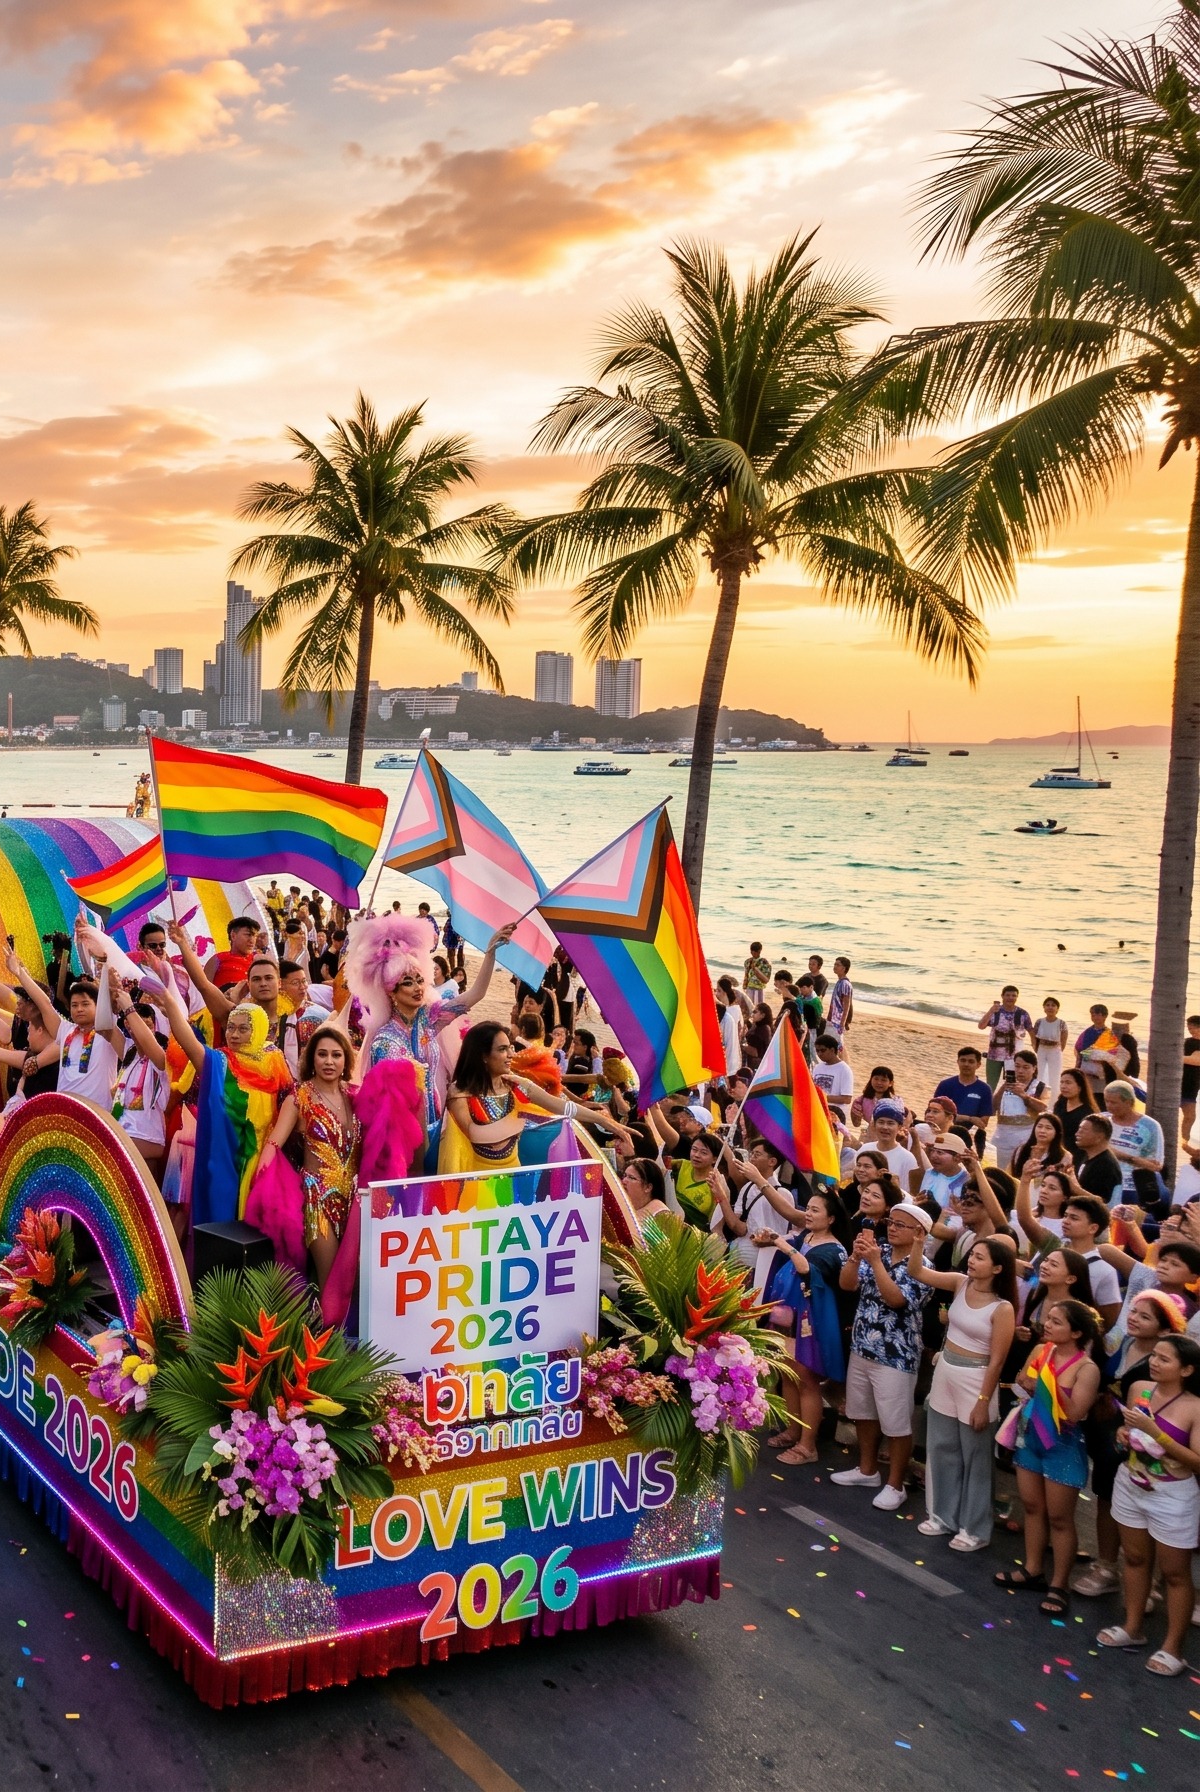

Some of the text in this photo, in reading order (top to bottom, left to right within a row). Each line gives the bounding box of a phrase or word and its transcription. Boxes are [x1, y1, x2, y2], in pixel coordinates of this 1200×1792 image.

[379, 1208, 589, 1268] PATTAYA
[395, 1249, 576, 1316] PRIDE
[430, 1305, 540, 1355] 2026
[44, 1374, 140, 1523] 2026
[334, 1449, 678, 1570] LOVE WINS
[418, 1545, 580, 1642] 2026
